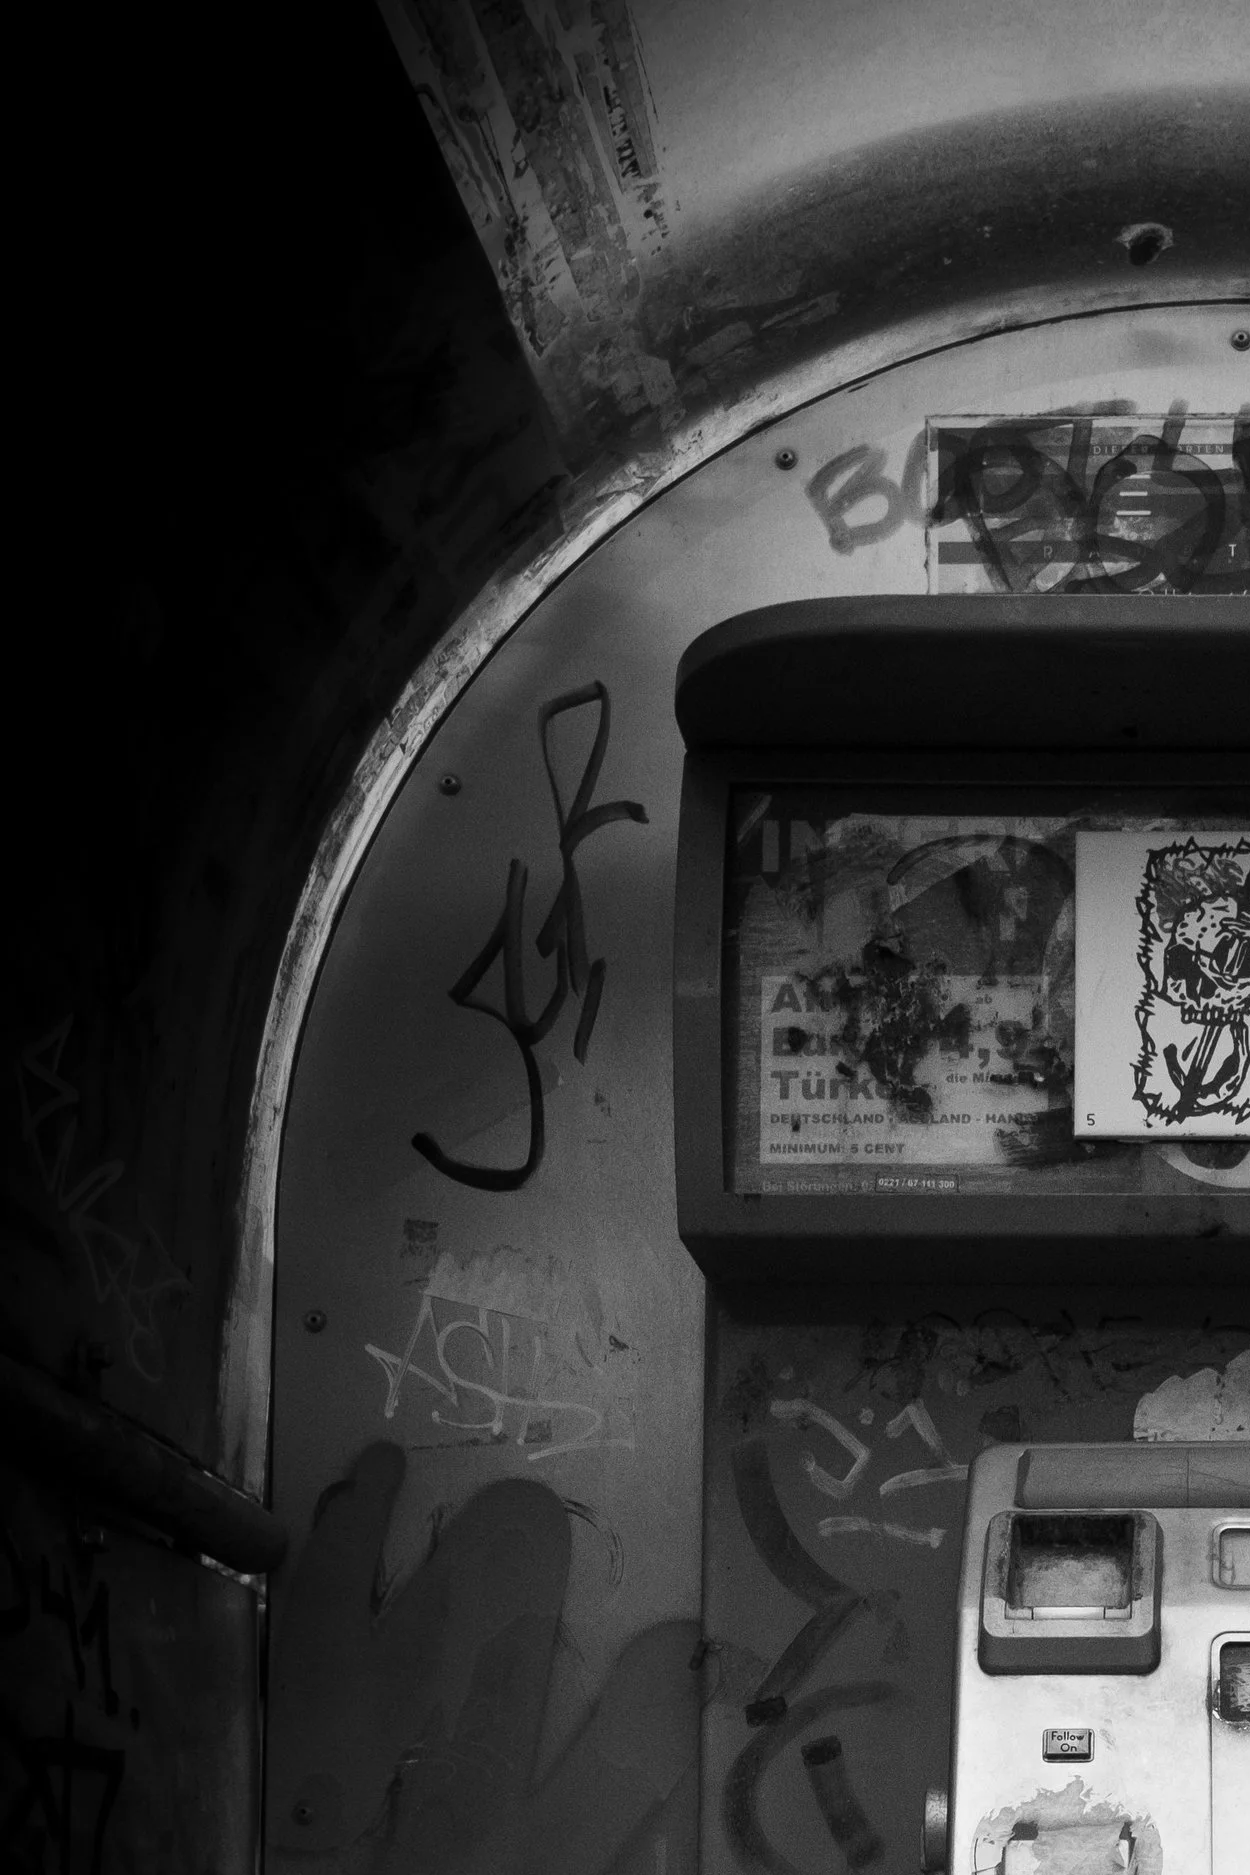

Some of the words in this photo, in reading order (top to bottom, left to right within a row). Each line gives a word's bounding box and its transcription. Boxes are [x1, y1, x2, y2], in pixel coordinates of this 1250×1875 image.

[1086, 1113, 1096, 1126] 5
[850, 1143, 859, 1154] 5
[864, 1143, 905, 1154] CENT
[1051, 1731, 1084, 1741] Follow
[1060, 1742, 1077, 1752] On
